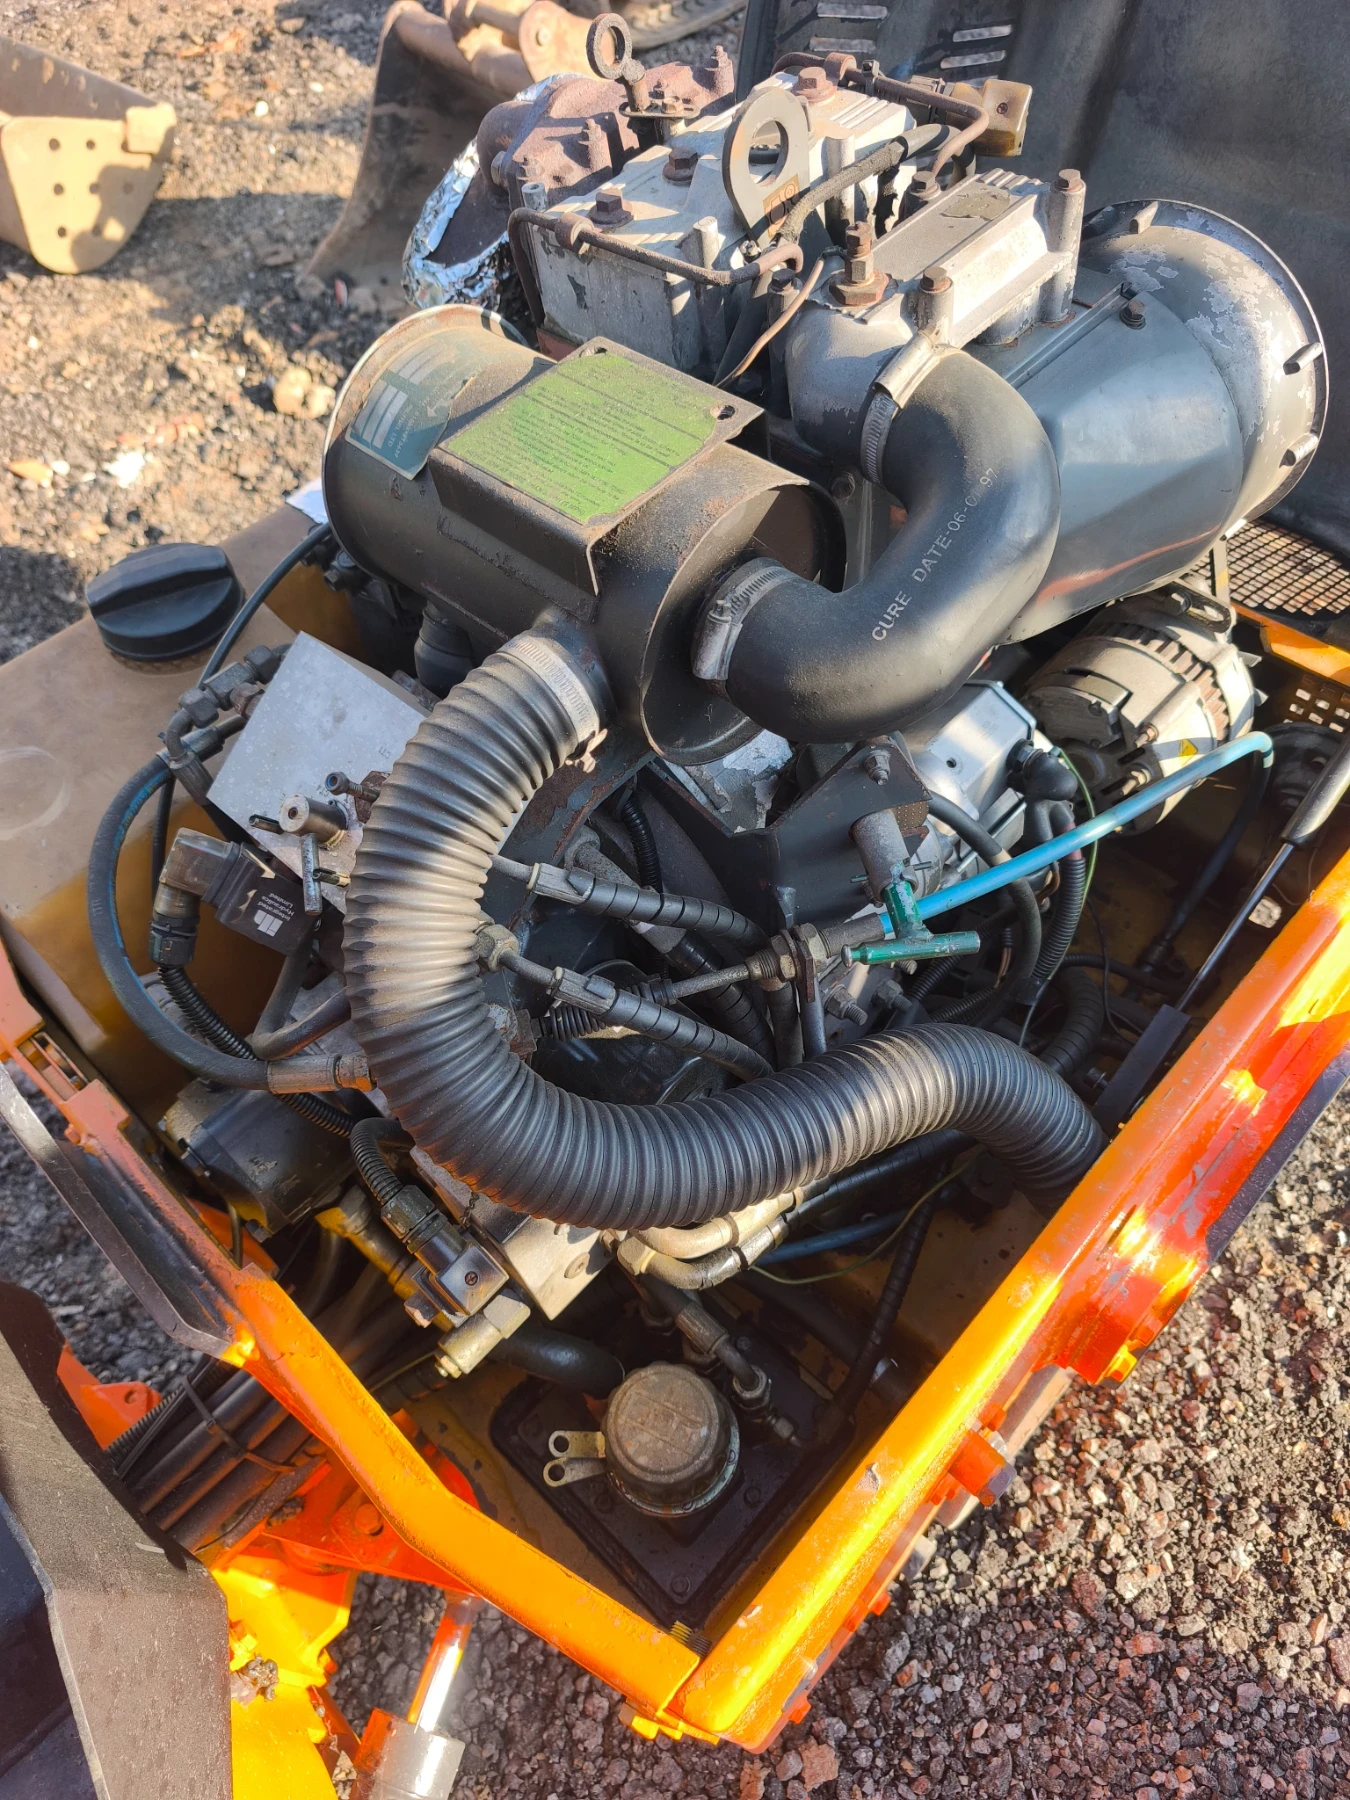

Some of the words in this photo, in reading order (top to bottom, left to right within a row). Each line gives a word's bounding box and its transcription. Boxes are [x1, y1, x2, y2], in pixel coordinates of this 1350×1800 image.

[872, 590, 912, 641] CURE
[261, 895, 295, 916] Hydraulics
[269, 892, 294, 909] Limited
[257, 901, 291, 921] Integrated
